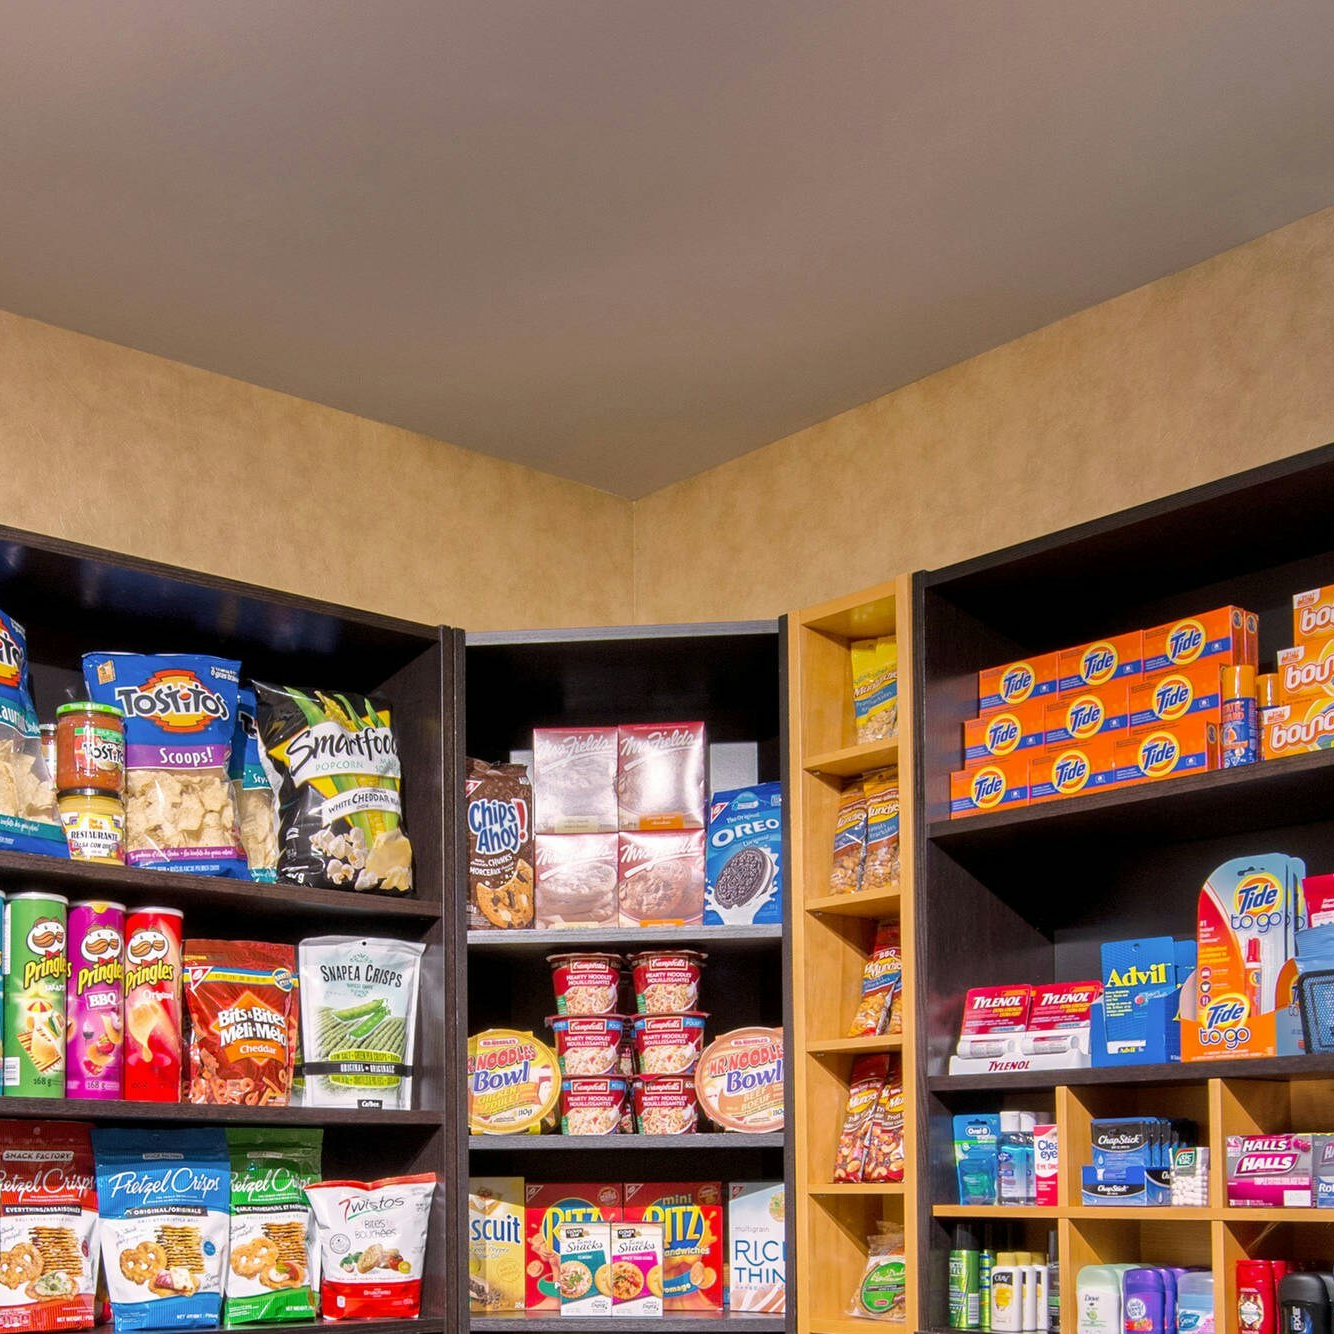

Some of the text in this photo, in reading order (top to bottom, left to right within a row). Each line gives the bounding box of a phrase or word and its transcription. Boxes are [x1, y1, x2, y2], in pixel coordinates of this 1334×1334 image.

[1002, 670, 1032, 697] Tide
[115, 684, 230, 719] TOSTITOS
[160, 747, 214, 765] Scoops!
[972, 777, 1003, 802] Tide
[468, 798, 516, 833] Chips
[711, 818, 779, 848] OREO
[1238, 886, 1278, 915] Tide
[1230, 913, 1282, 933] to go
[125, 964, 174, 997] Pringles
[320, 964, 403, 987] SNAPEA CRISPS
[1106, 963, 1166, 987] Advil
[88, 992, 117, 1008] BBQ
[973, 996, 1021, 1009] TYLENOL
[240, 1045, 277, 1055] Cheddar
[473, 1061, 529, 1091] Bowl
[988, 1061, 1030, 1071] TYLENOL
[1098, 1134, 1140, 1144] ChapStick
[3, 1152, 72, 1160] SNACK FACTORY
[663, 1194, 692, 1205] mini
